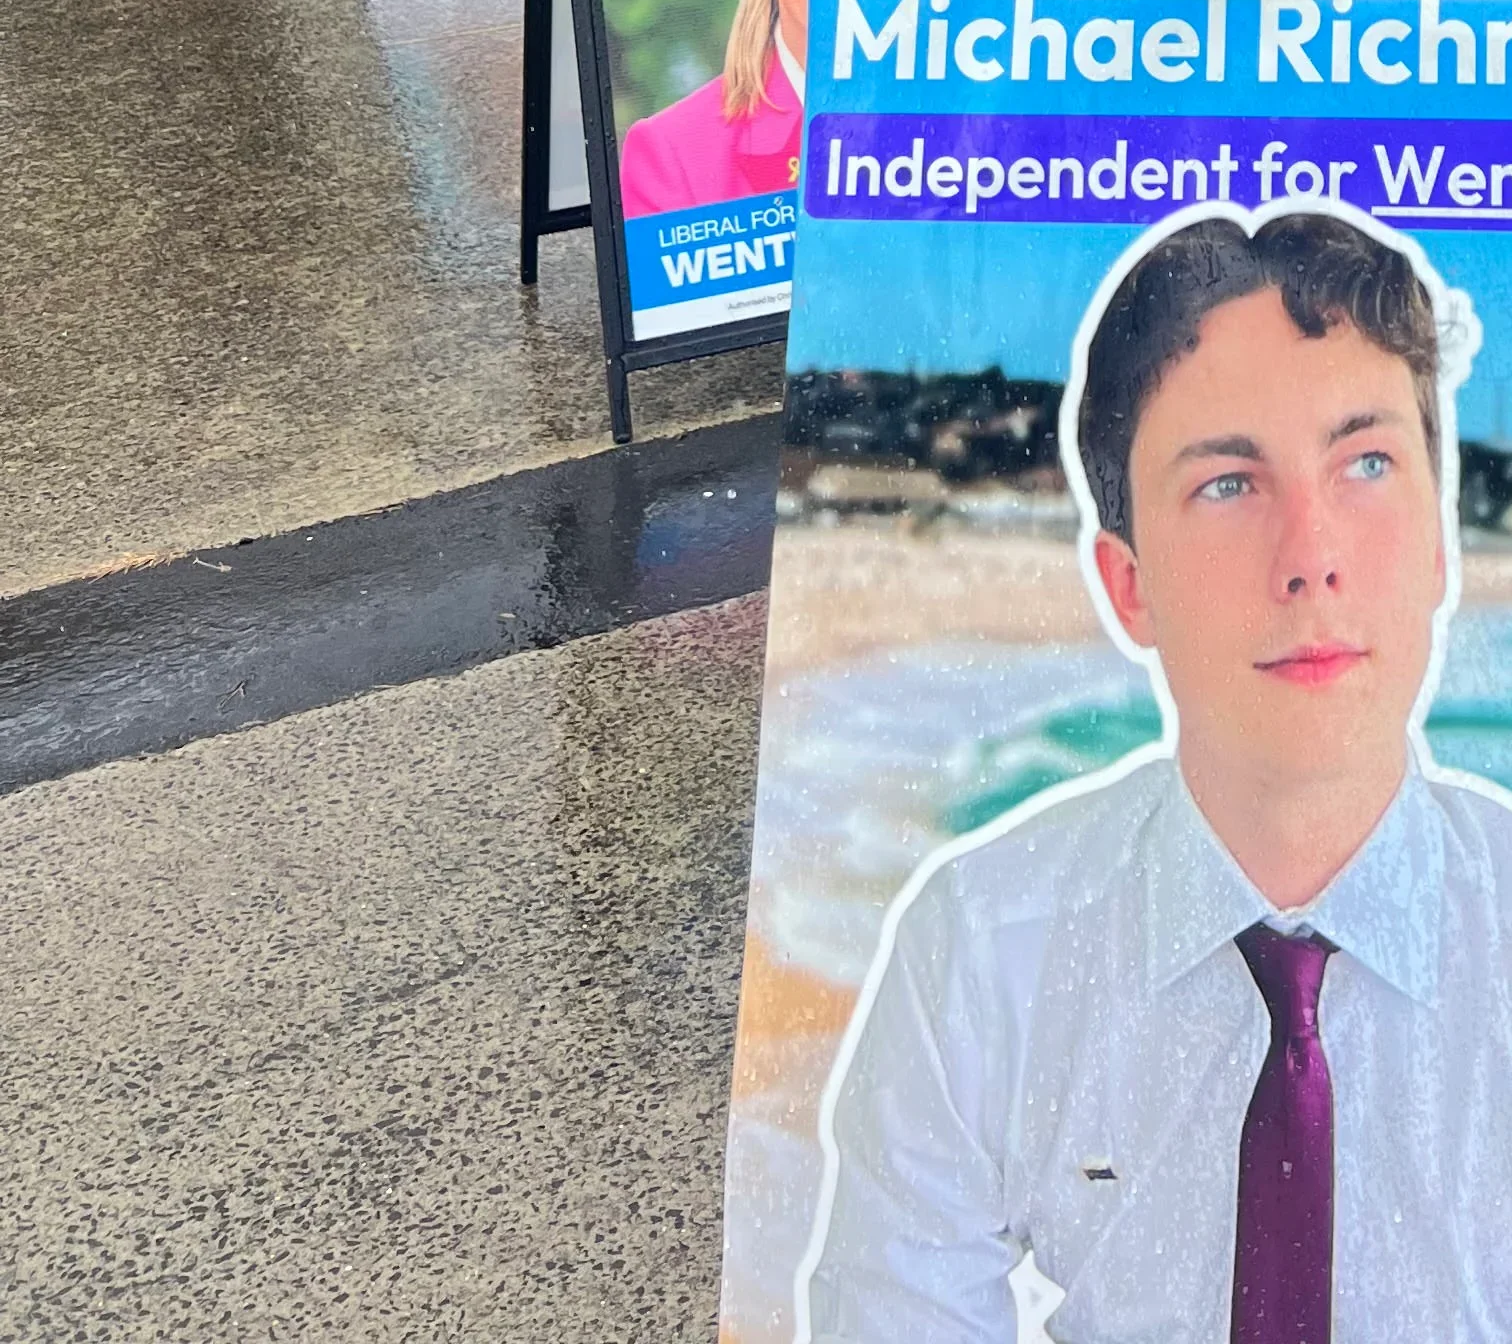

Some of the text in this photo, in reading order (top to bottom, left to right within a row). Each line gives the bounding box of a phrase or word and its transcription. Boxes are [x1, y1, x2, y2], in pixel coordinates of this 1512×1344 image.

[827, 139, 1236, 200] Independent
[1253, 141, 1358, 198] for
[659, 205, 796, 248] LIBERAL FOR
[661, 231, 796, 288] WENT
